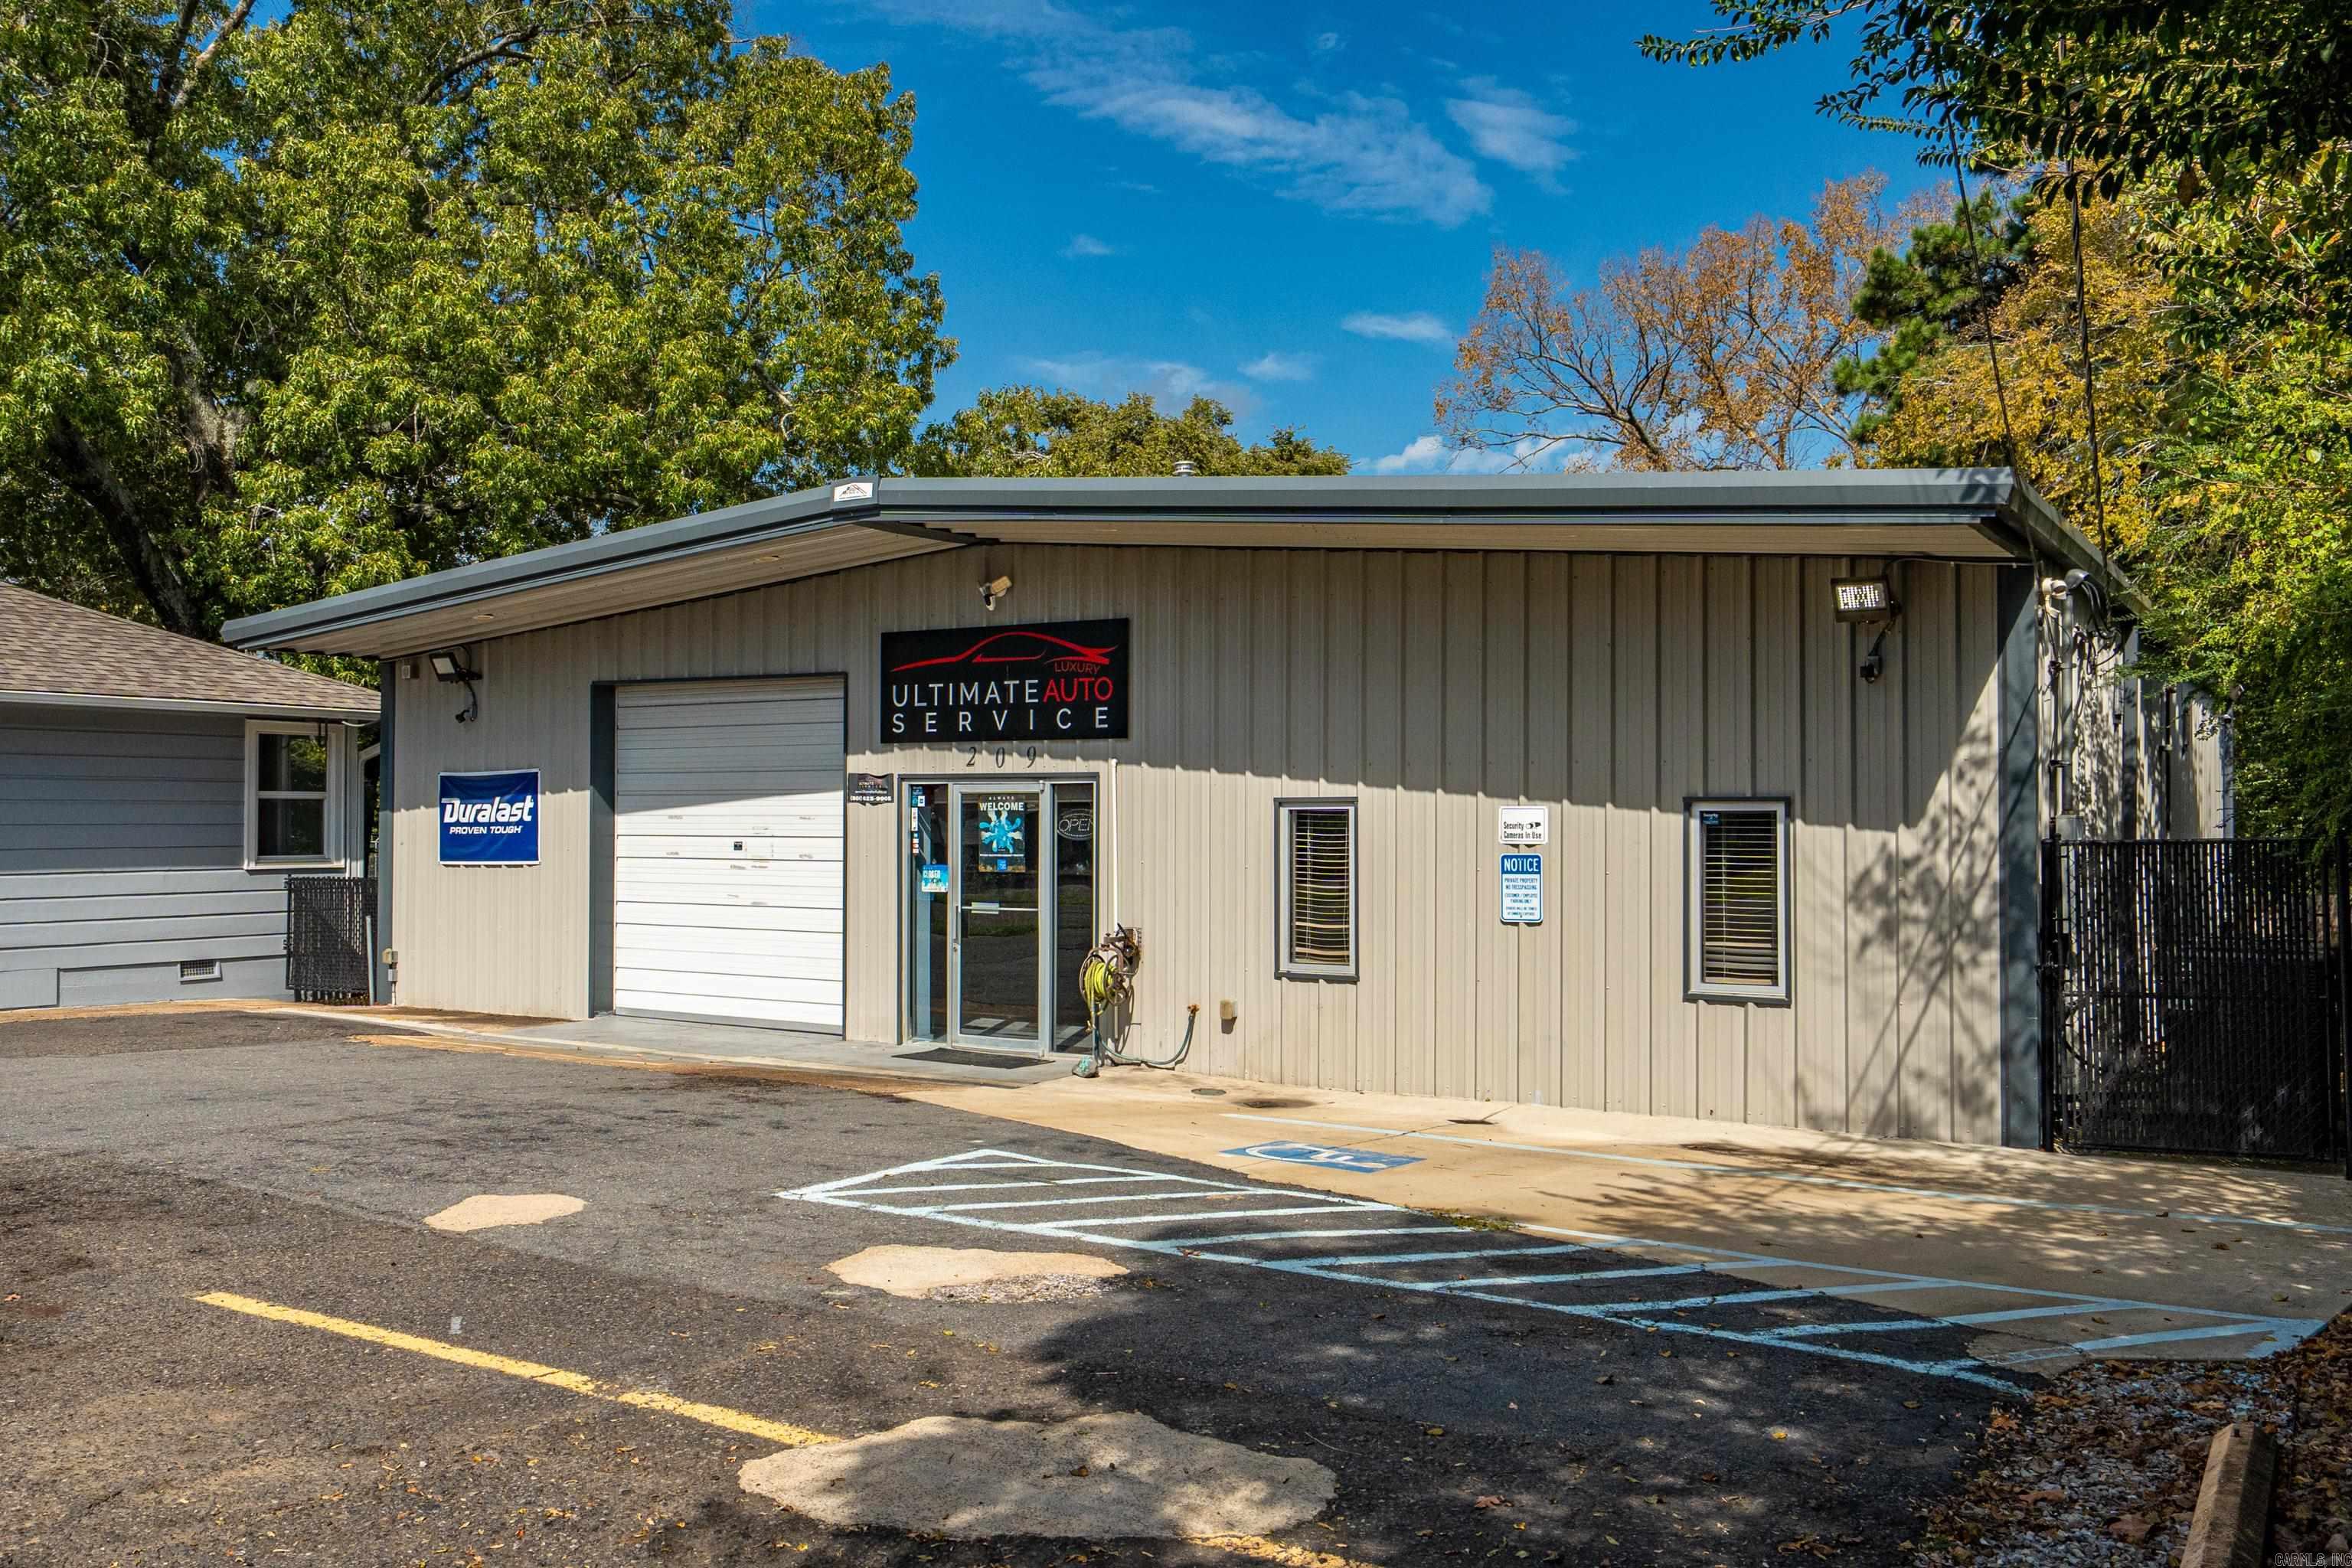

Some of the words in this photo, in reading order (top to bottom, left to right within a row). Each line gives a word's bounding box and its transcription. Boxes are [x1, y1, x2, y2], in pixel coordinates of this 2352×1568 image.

[1054, 662, 1101, 675] LUXURY
[892, 679, 1039, 707] ULTIMATE
[1042, 677, 1114, 703] AUTO
[892, 707, 1109, 733] SERVICE
[966, 746, 1037, 768] 209
[441, 795, 534, 823] Duralast
[979, 802, 1024, 812] WELCOME
[449, 826, 487, 835] PROVEN
[490, 825, 522, 834] TOUGH
[1504, 822, 1524, 831] Security
[1504, 831, 1524, 839] Cameras
[1504, 858, 1539, 871] NOTICE
